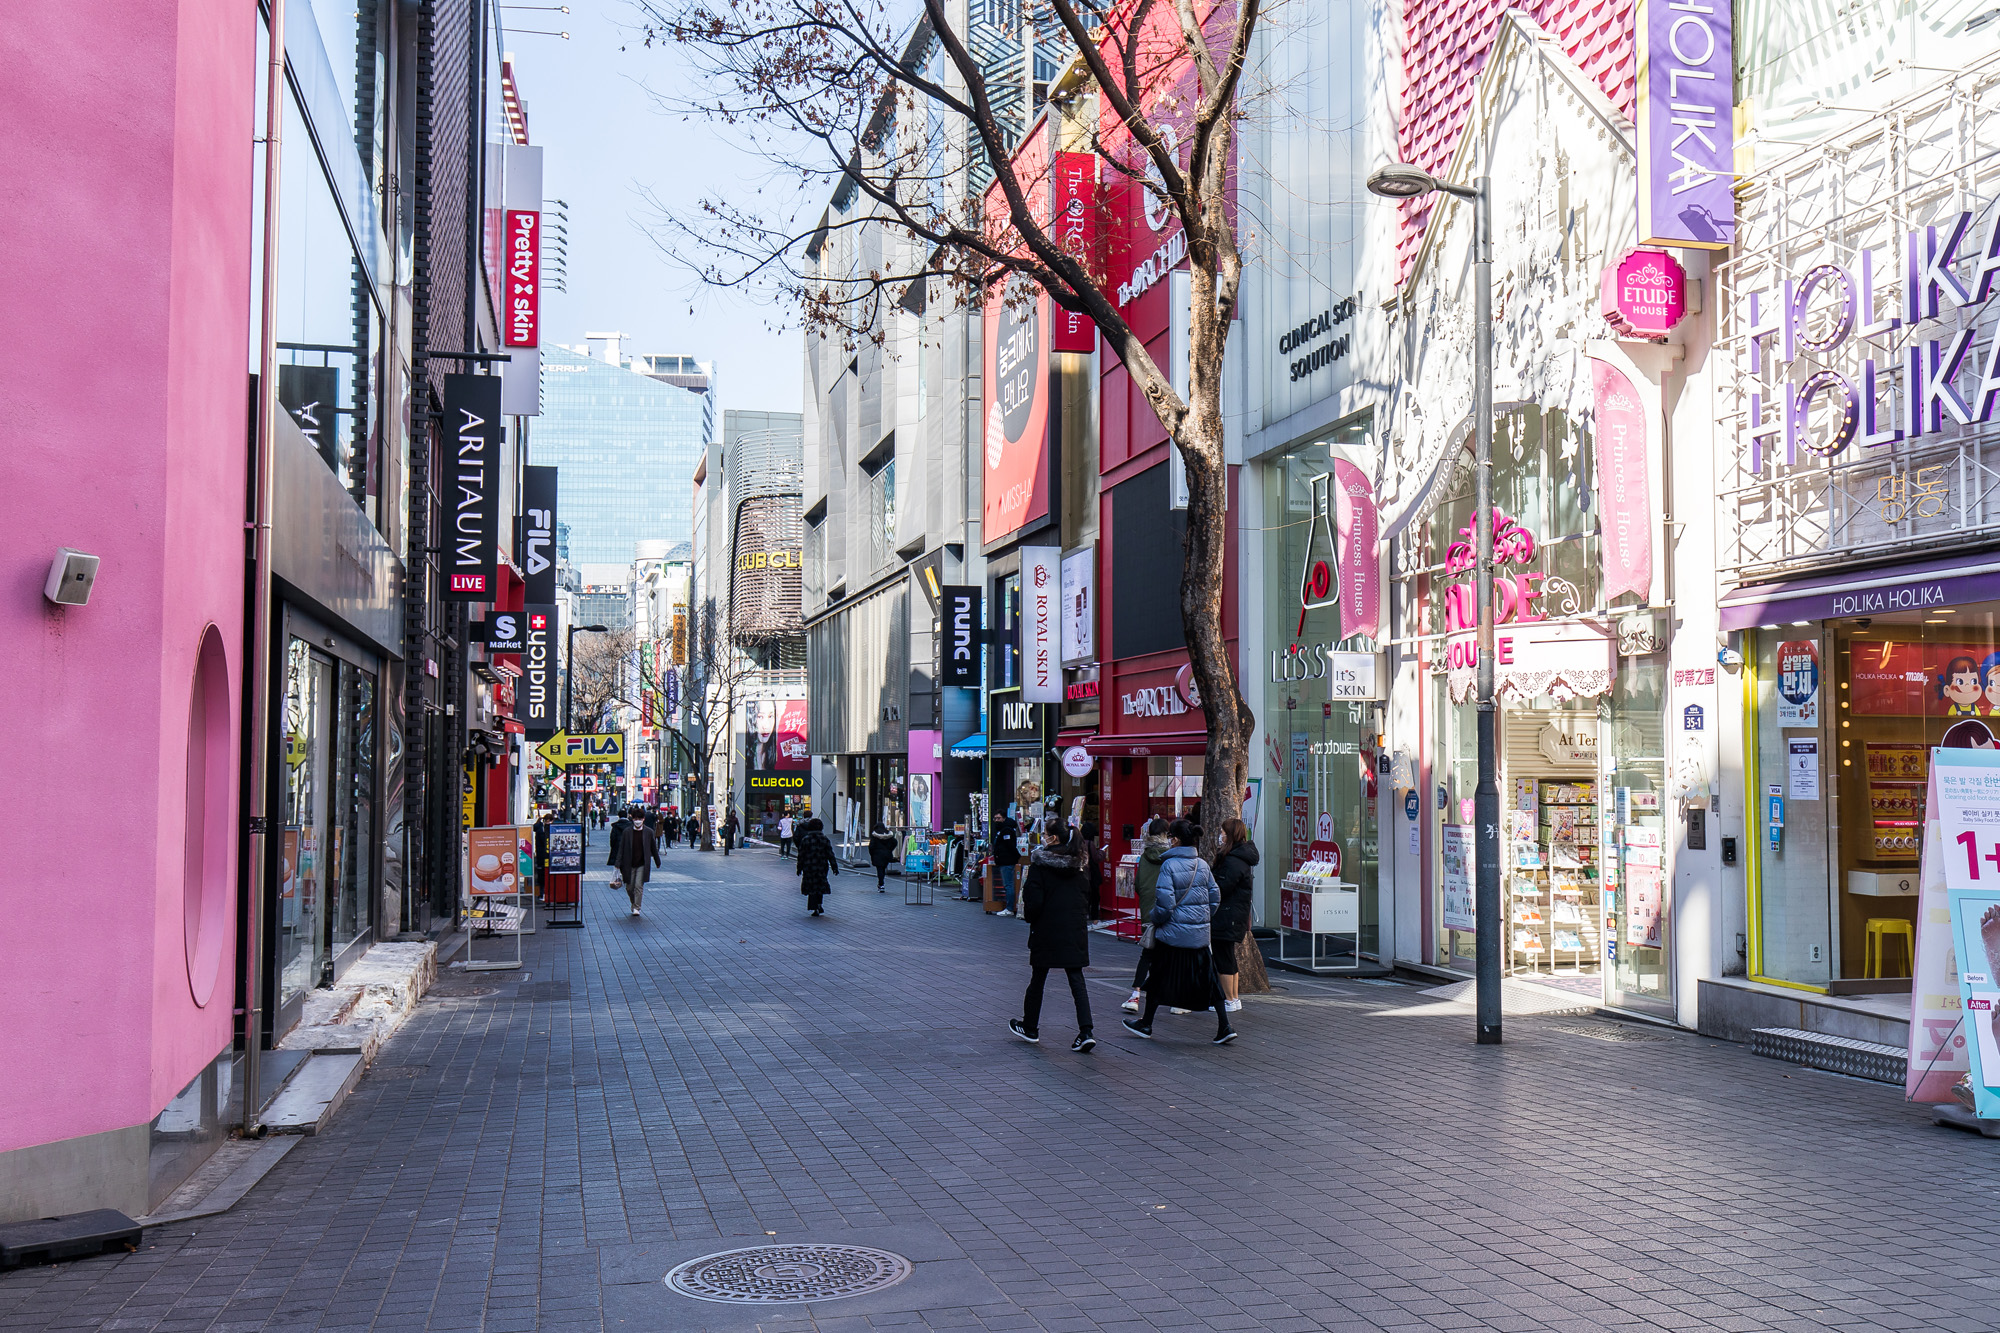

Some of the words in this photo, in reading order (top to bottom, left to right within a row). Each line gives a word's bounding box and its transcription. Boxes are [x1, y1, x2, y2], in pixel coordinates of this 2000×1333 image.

[511, 214, 534, 281] Pretty
[1624, 286, 1677, 305] ETUDE
[513, 298, 534, 342] skin
[1279, 310, 1332, 354] CLINICAL
[1333, 290, 1363, 325] SKIN
[1632, 306, 1668, 316] HOUSE
[1290, 333, 1350, 382] SOLUTION
[1612, 423, 1628, 503] Princess
[456, 407, 485, 566] ARITAUM
[1001, 478, 1032, 516] MISSHA
[1878, 464, 1950, 524] 명동
[527, 508, 551, 575] FILA
[1352, 506, 1363, 567] Princess
[1616, 510, 1631, 569] House
[738, 552, 767, 571] CLUB
[453, 577, 482, 589] LIVE
[1354, 572, 1365, 618] House
[1832, 593, 1884, 614] HOLIKA
[1889, 585, 1944, 607] HOLIKA
[495, 615, 517, 639] S
[954, 596, 971, 660] nunc
[1036, 594, 1048, 647] ROYAL
[489, 640, 522, 649] Market
[1448, 637, 1514, 670] HOUE
[527, 630, 547, 719] swatch
[1036, 648, 1048, 688] SKIN
[1783, 654, 1812, 671] 삼일절
[1067, 683, 1085, 700] ROYAL
[1085, 681, 1099, 697] SKIN
[1335, 685, 1366, 696] SKIN
[1674, 667, 1715, 687] 伊蒂之屋
[1783, 671, 1812, 695] 만세
[1002, 702, 1034, 730] nunc
[1686, 717, 1701, 728] 35-1
[566, 737, 620, 755] FILA
[1559, 733, 1573, 746] At
[1294, 800, 1307, 812] SALE
[1407, 800, 1417, 809] ADT
[1319, 821, 1331, 838] 1+1
[1970, 1001, 1989, 1009] After
